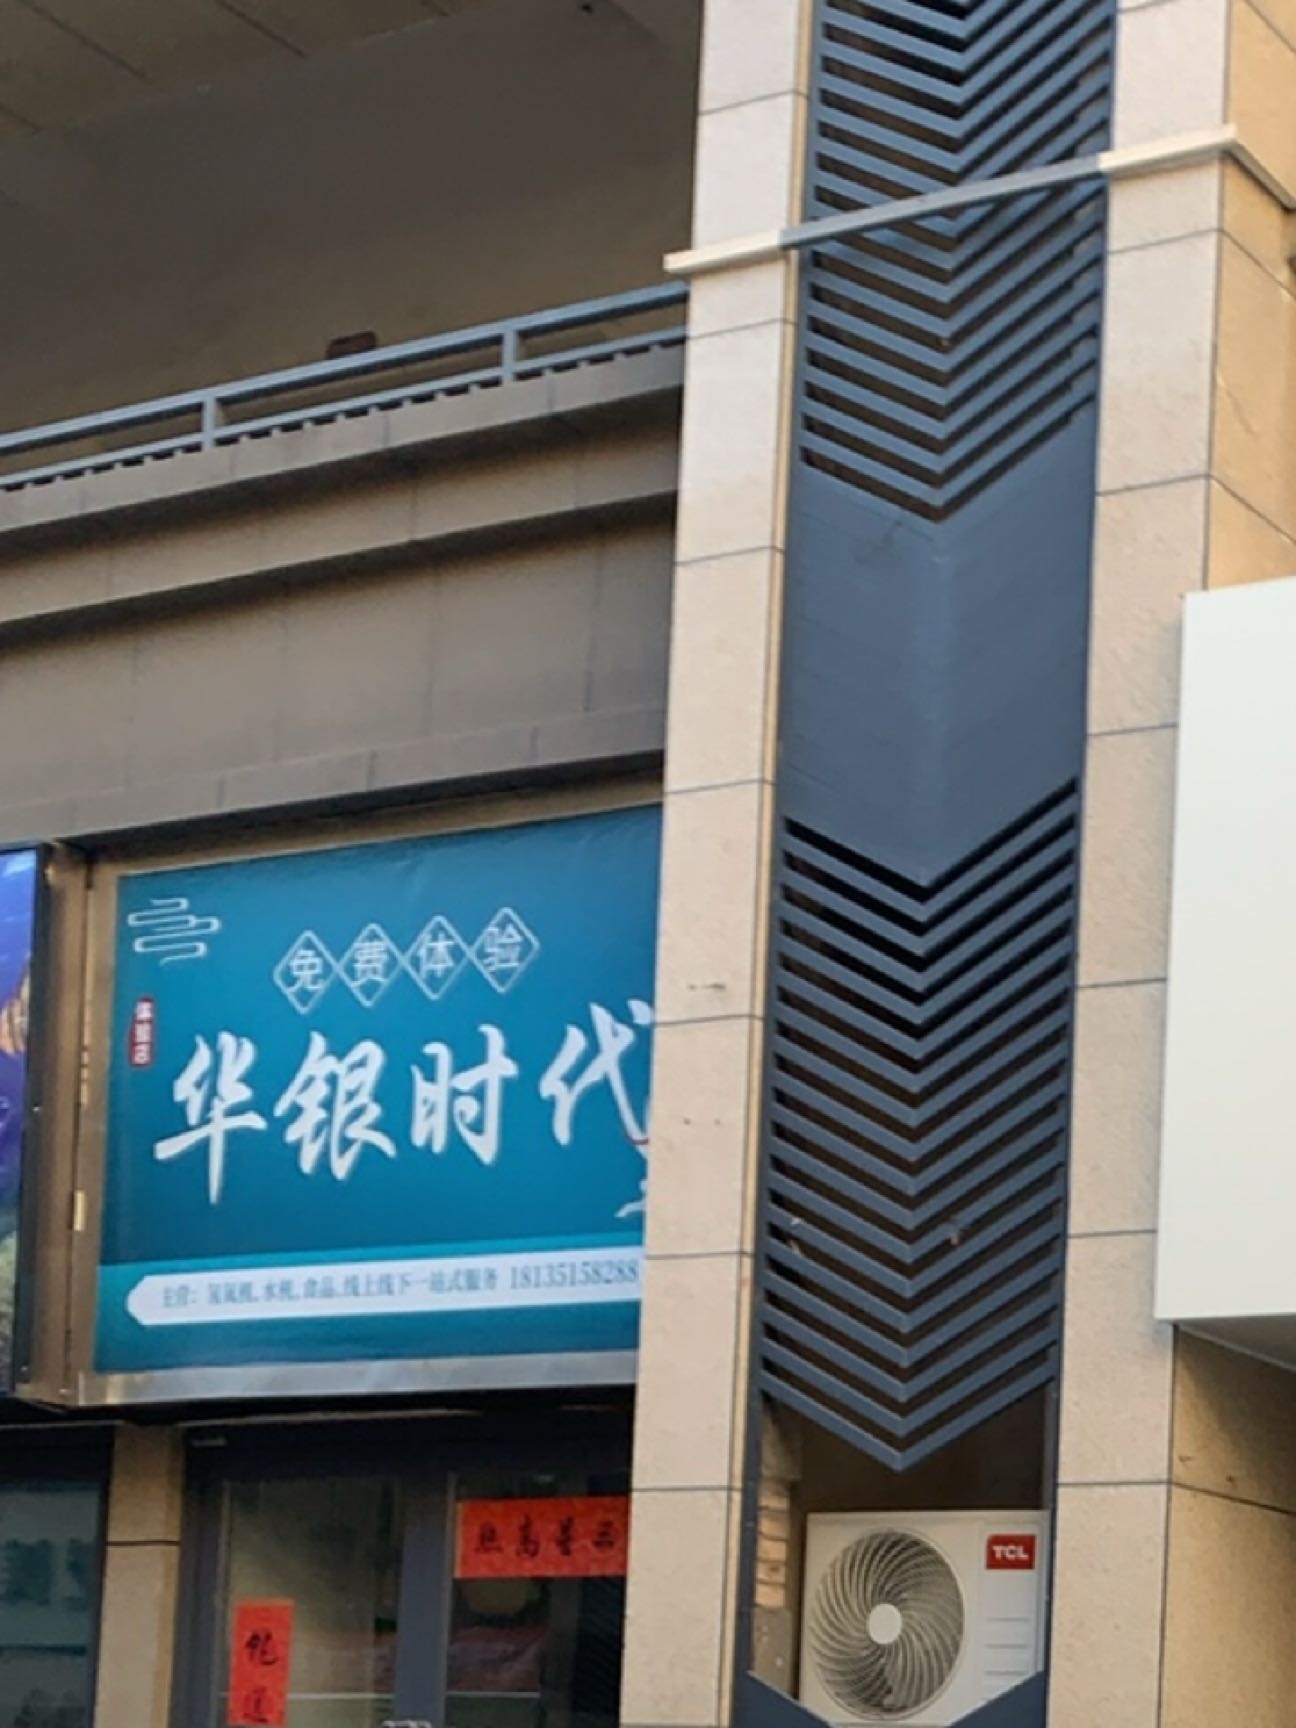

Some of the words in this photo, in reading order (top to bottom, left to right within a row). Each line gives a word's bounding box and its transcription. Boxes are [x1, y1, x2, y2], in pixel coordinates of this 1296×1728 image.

[288, 923, 523, 993] 免费体验
[510, 1259, 639, 1290] 18135158288
[992, 1545, 1029, 1560] TCL
